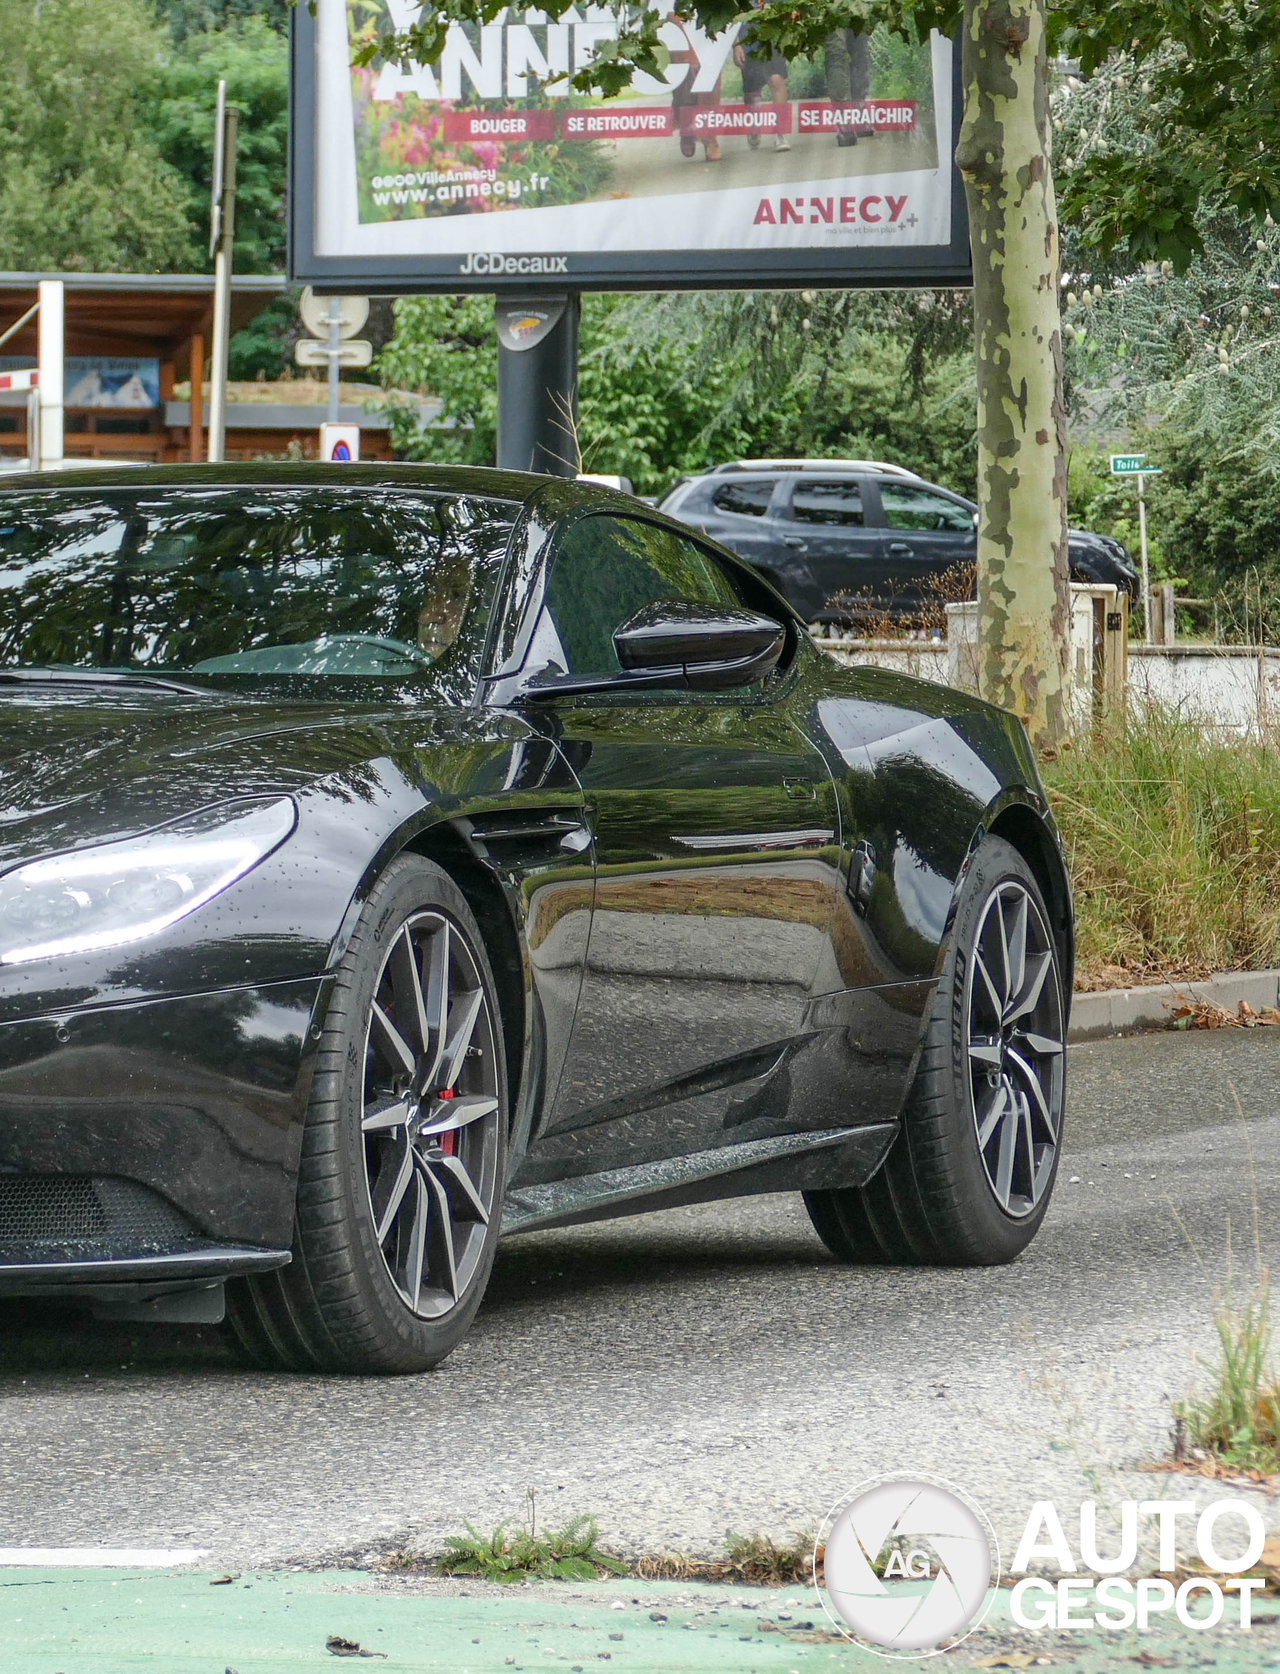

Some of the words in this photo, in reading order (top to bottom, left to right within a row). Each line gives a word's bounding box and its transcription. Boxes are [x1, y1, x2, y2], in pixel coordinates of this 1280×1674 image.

[470, 118, 527, 134] BOUGER
[568, 117, 584, 132] SE
[587, 115, 666, 131] RETROUVER
[801, 110, 819, 126] SE
[822, 105, 913, 125] RAFRAÎCHIR
[416, 168, 497, 185] VilleAnnecy
[372, 173, 550, 206] www.annecy.fr
[753, 195, 909, 225] ANNECY
[863, 226, 879, 234] bien
[880, 226, 897, 235] plus
[460, 253, 568, 274] JCDecaux
[953, 956, 966, 1099] MICHELIN
